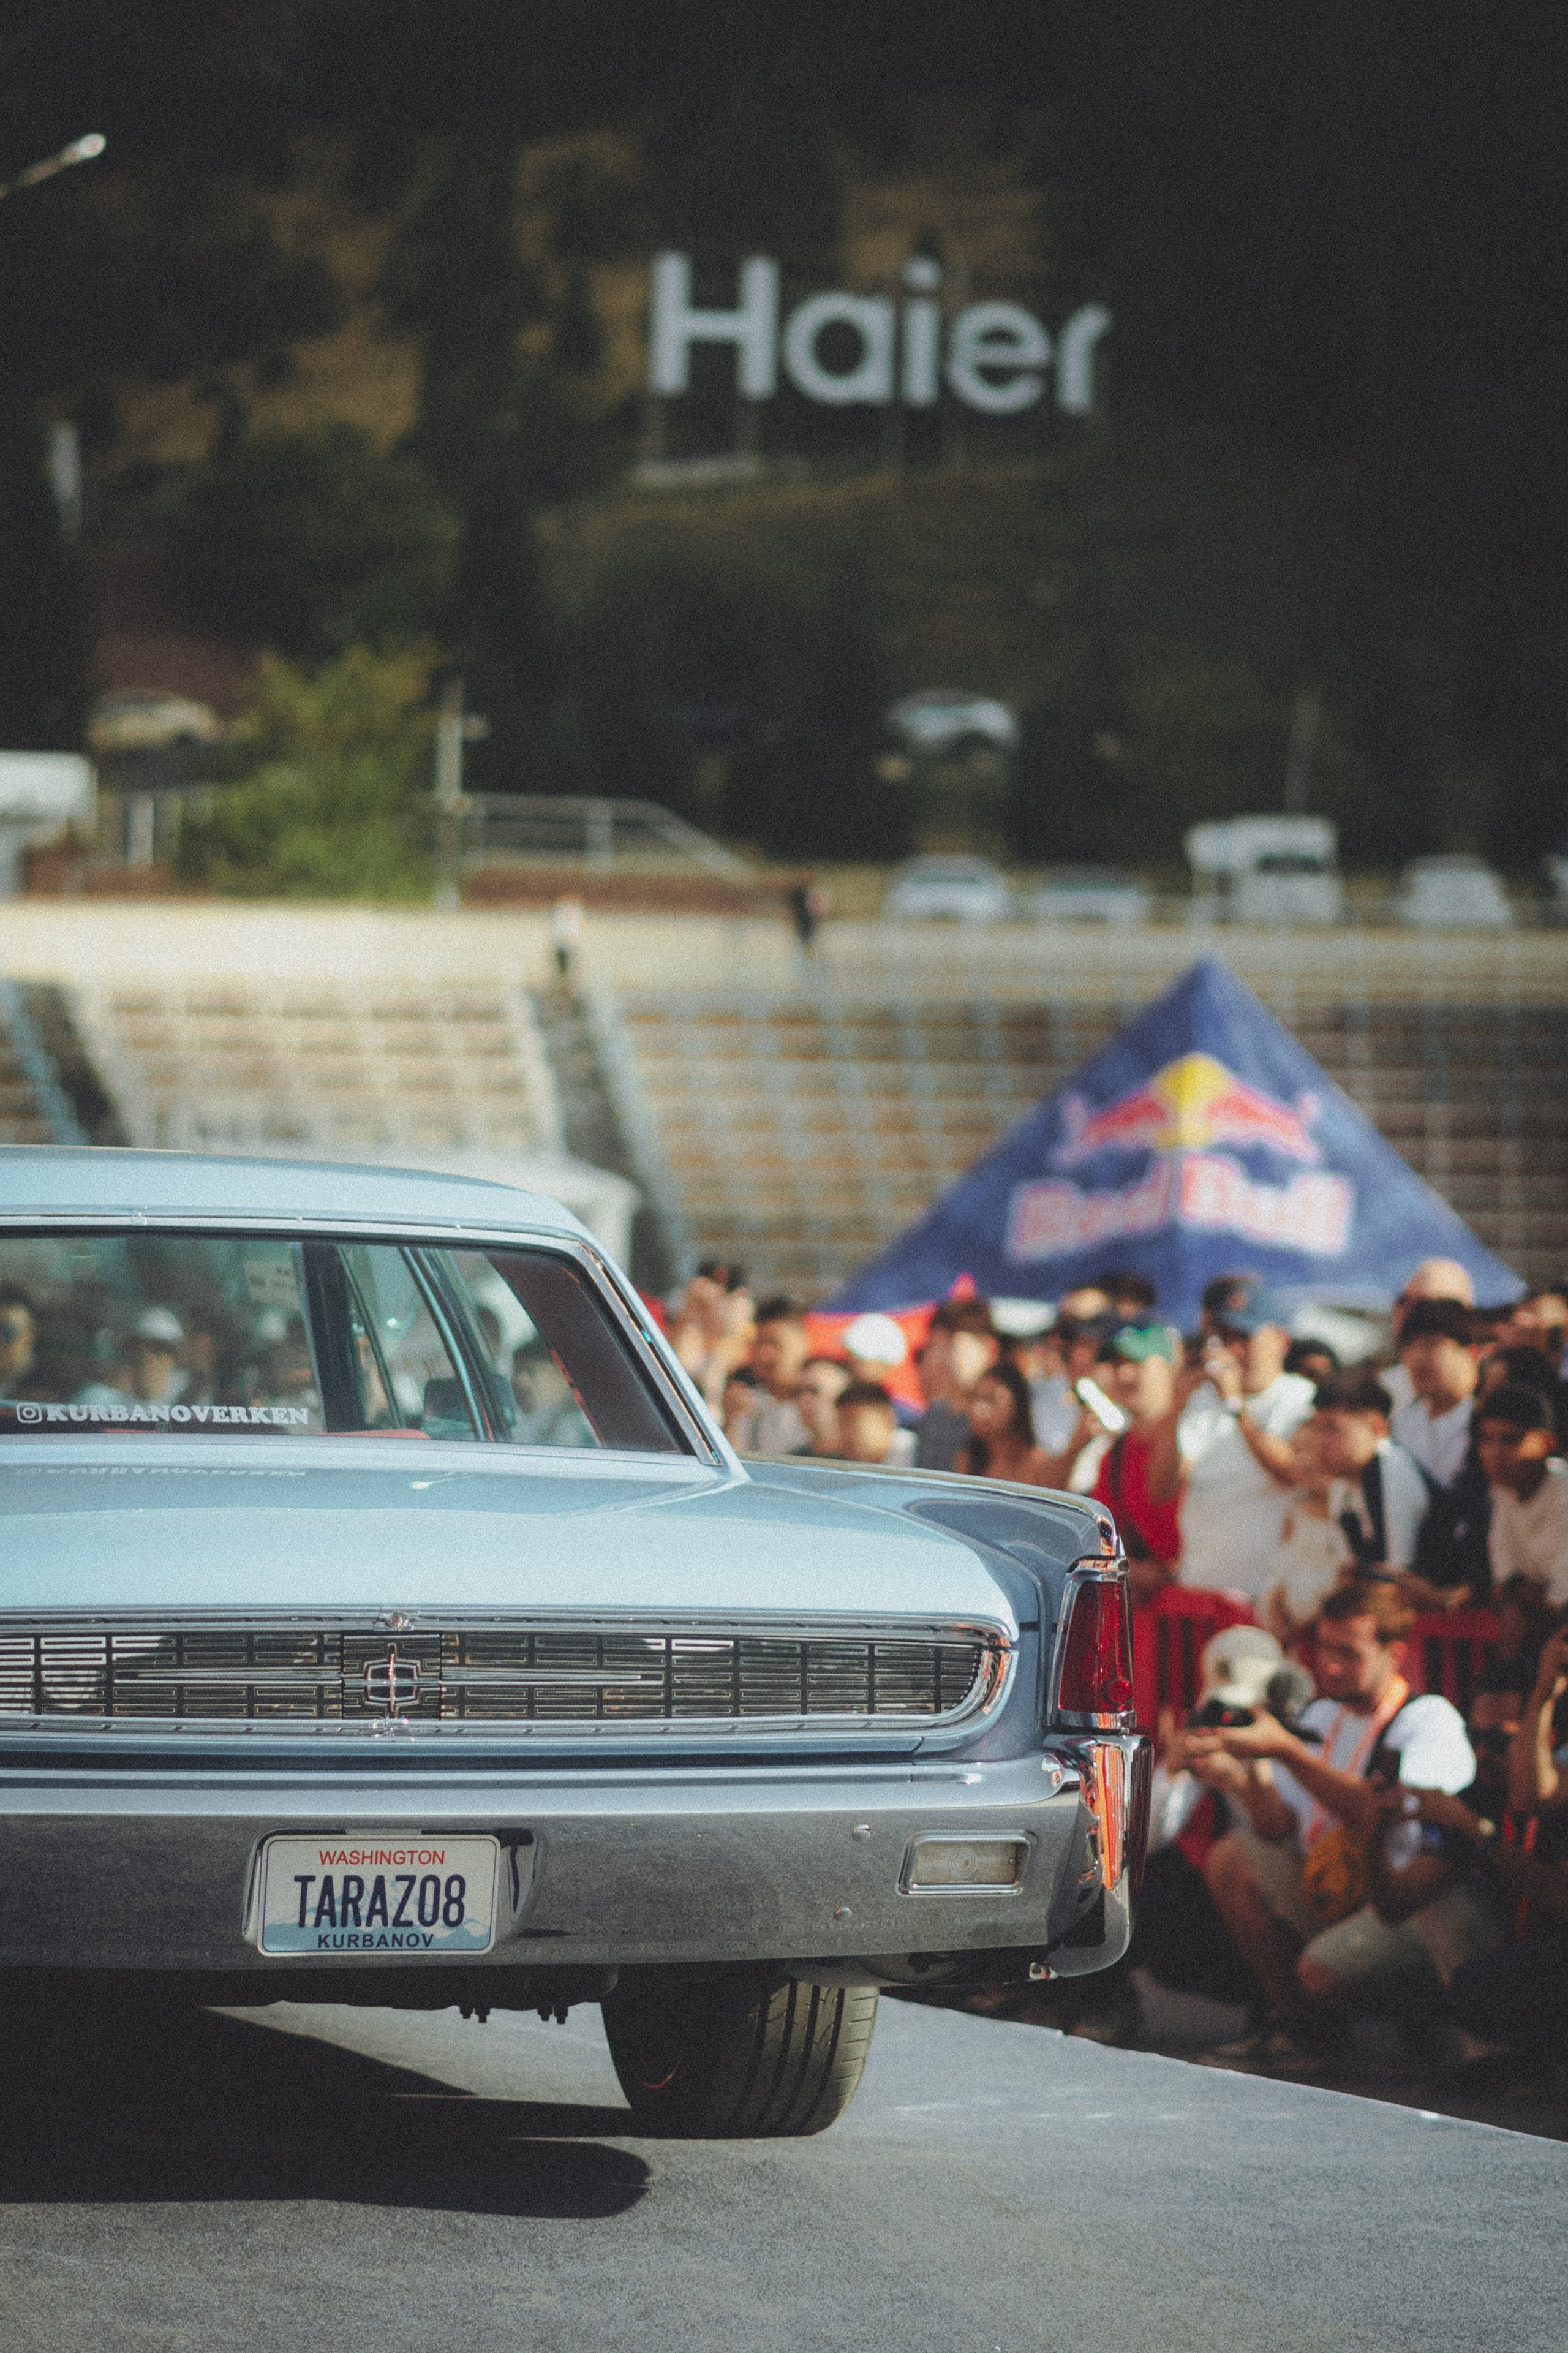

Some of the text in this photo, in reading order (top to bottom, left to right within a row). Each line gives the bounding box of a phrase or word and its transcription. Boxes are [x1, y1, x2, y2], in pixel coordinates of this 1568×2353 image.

[649, 250, 1110, 414] Haier
[47, 1404, 308, 1424] KURBANOVERKEN
[319, 1849, 445, 1865] WASHINGTON
[318, 1933, 434, 1949] KURBANOV
